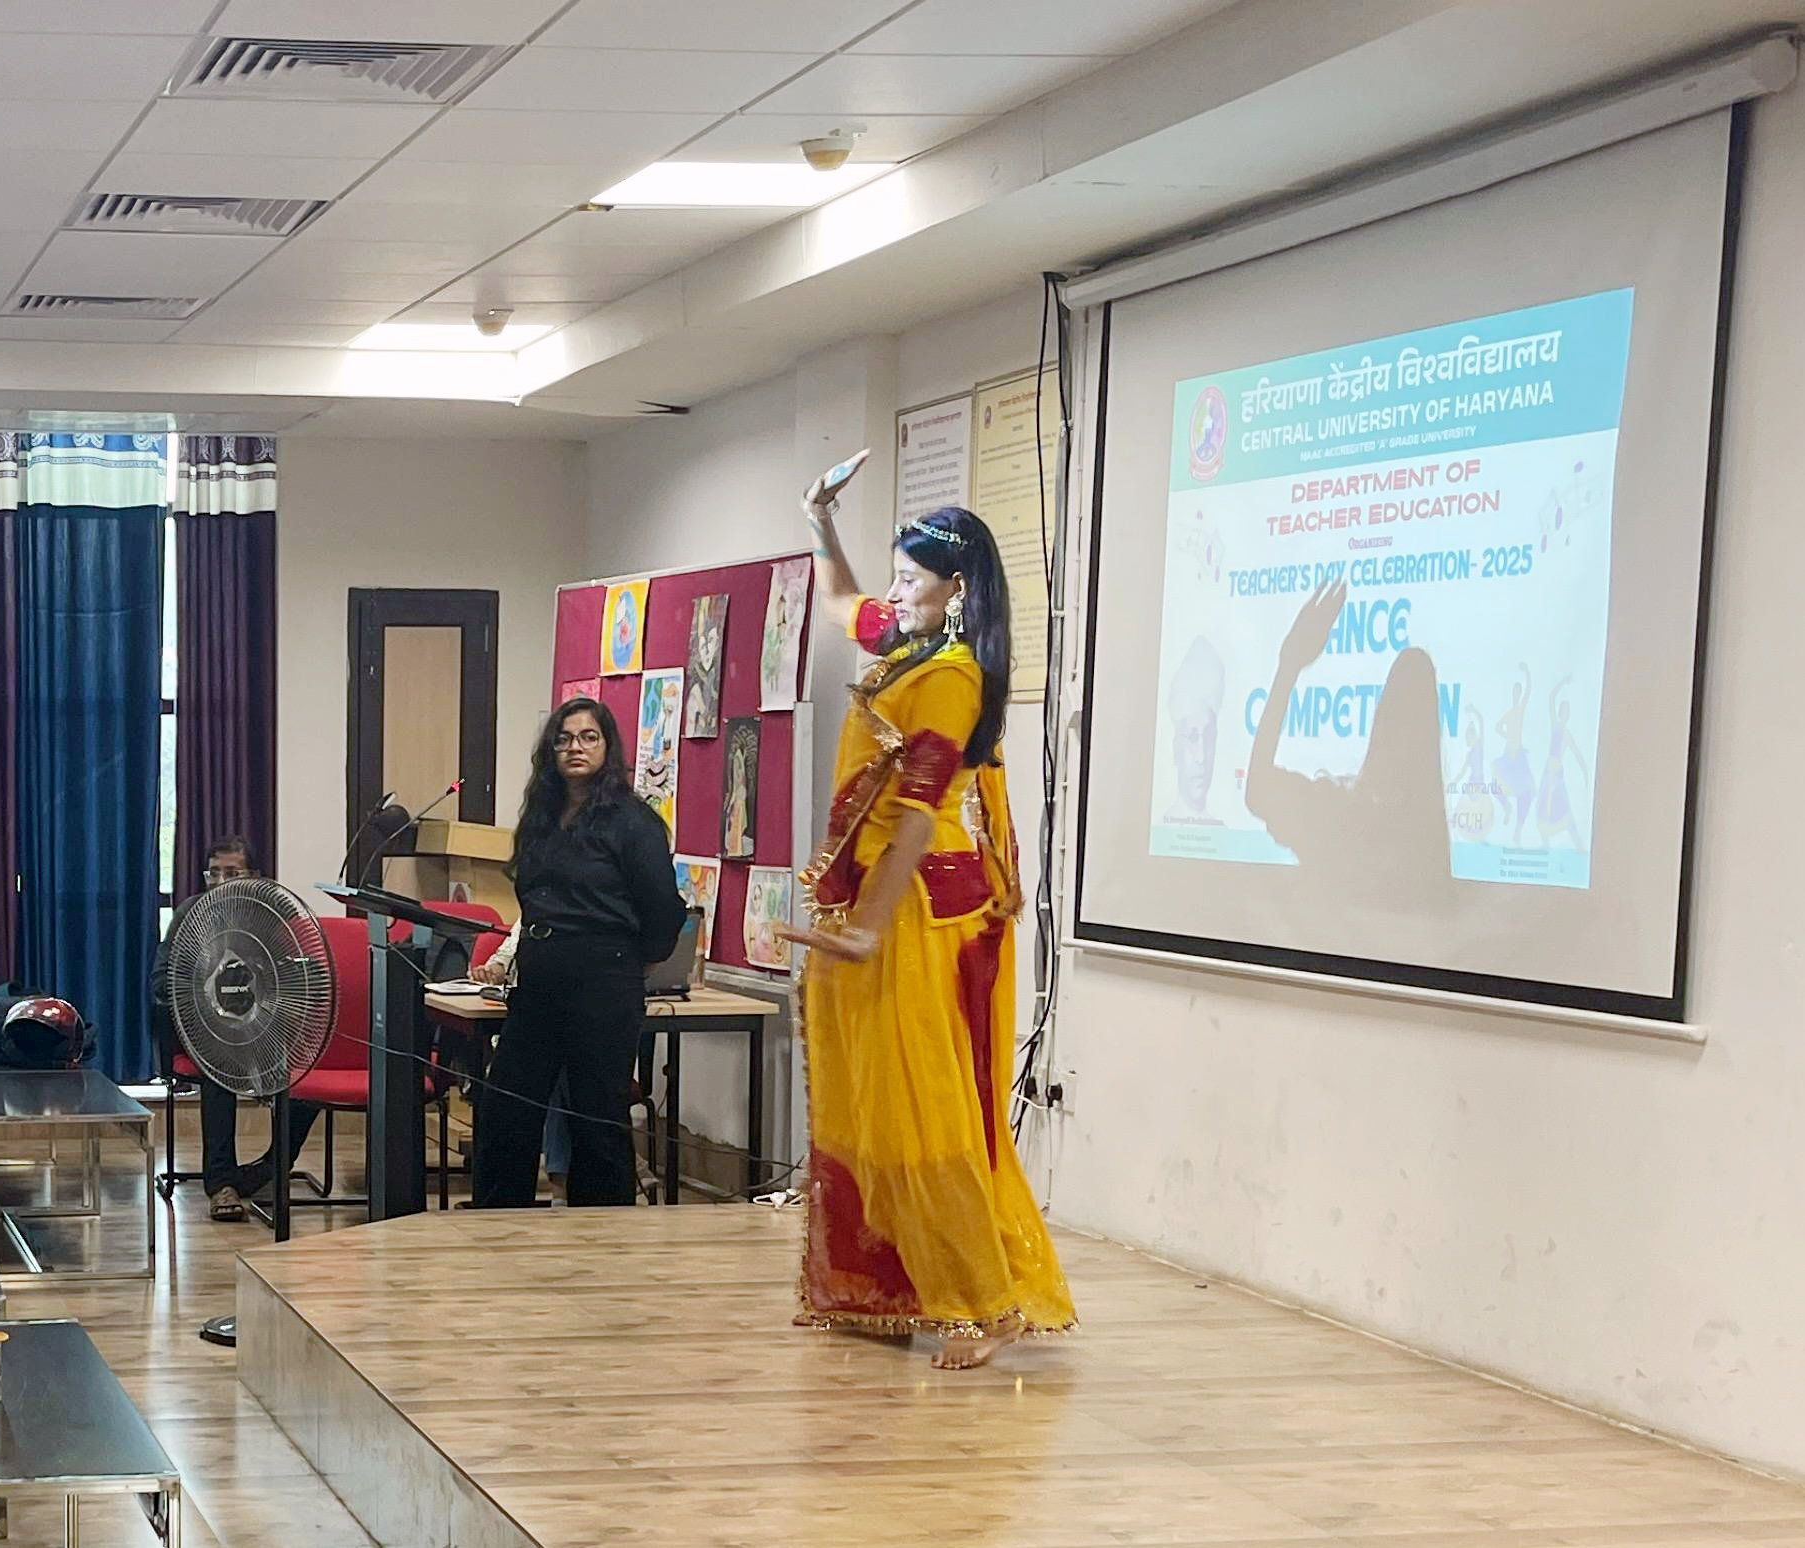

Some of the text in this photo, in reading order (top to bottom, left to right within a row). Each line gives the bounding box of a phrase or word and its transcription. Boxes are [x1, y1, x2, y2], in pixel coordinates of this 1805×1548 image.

[1241, 376, 1323, 423] हरियाणा
[1397, 330, 1562, 389] विश्वविद्यालय
[1241, 380, 1554, 453] CENTRAL UNIVERSITY OF HARYANA
[1324, 440, 1376, 459] ACCREDITED
[1389, 433, 1420, 449] GRADE
[1421, 425, 1477, 444] UNIVERSITY
[1291, 459, 1481, 503] DEPARTMENT OF
[1267, 490, 1500, 536] TEACHER EDUCATION
[1228, 564, 1311, 598] TEACHER'S
[1482, 544, 1533, 578] 2025
[1325, 598, 1412, 654] ANCE
